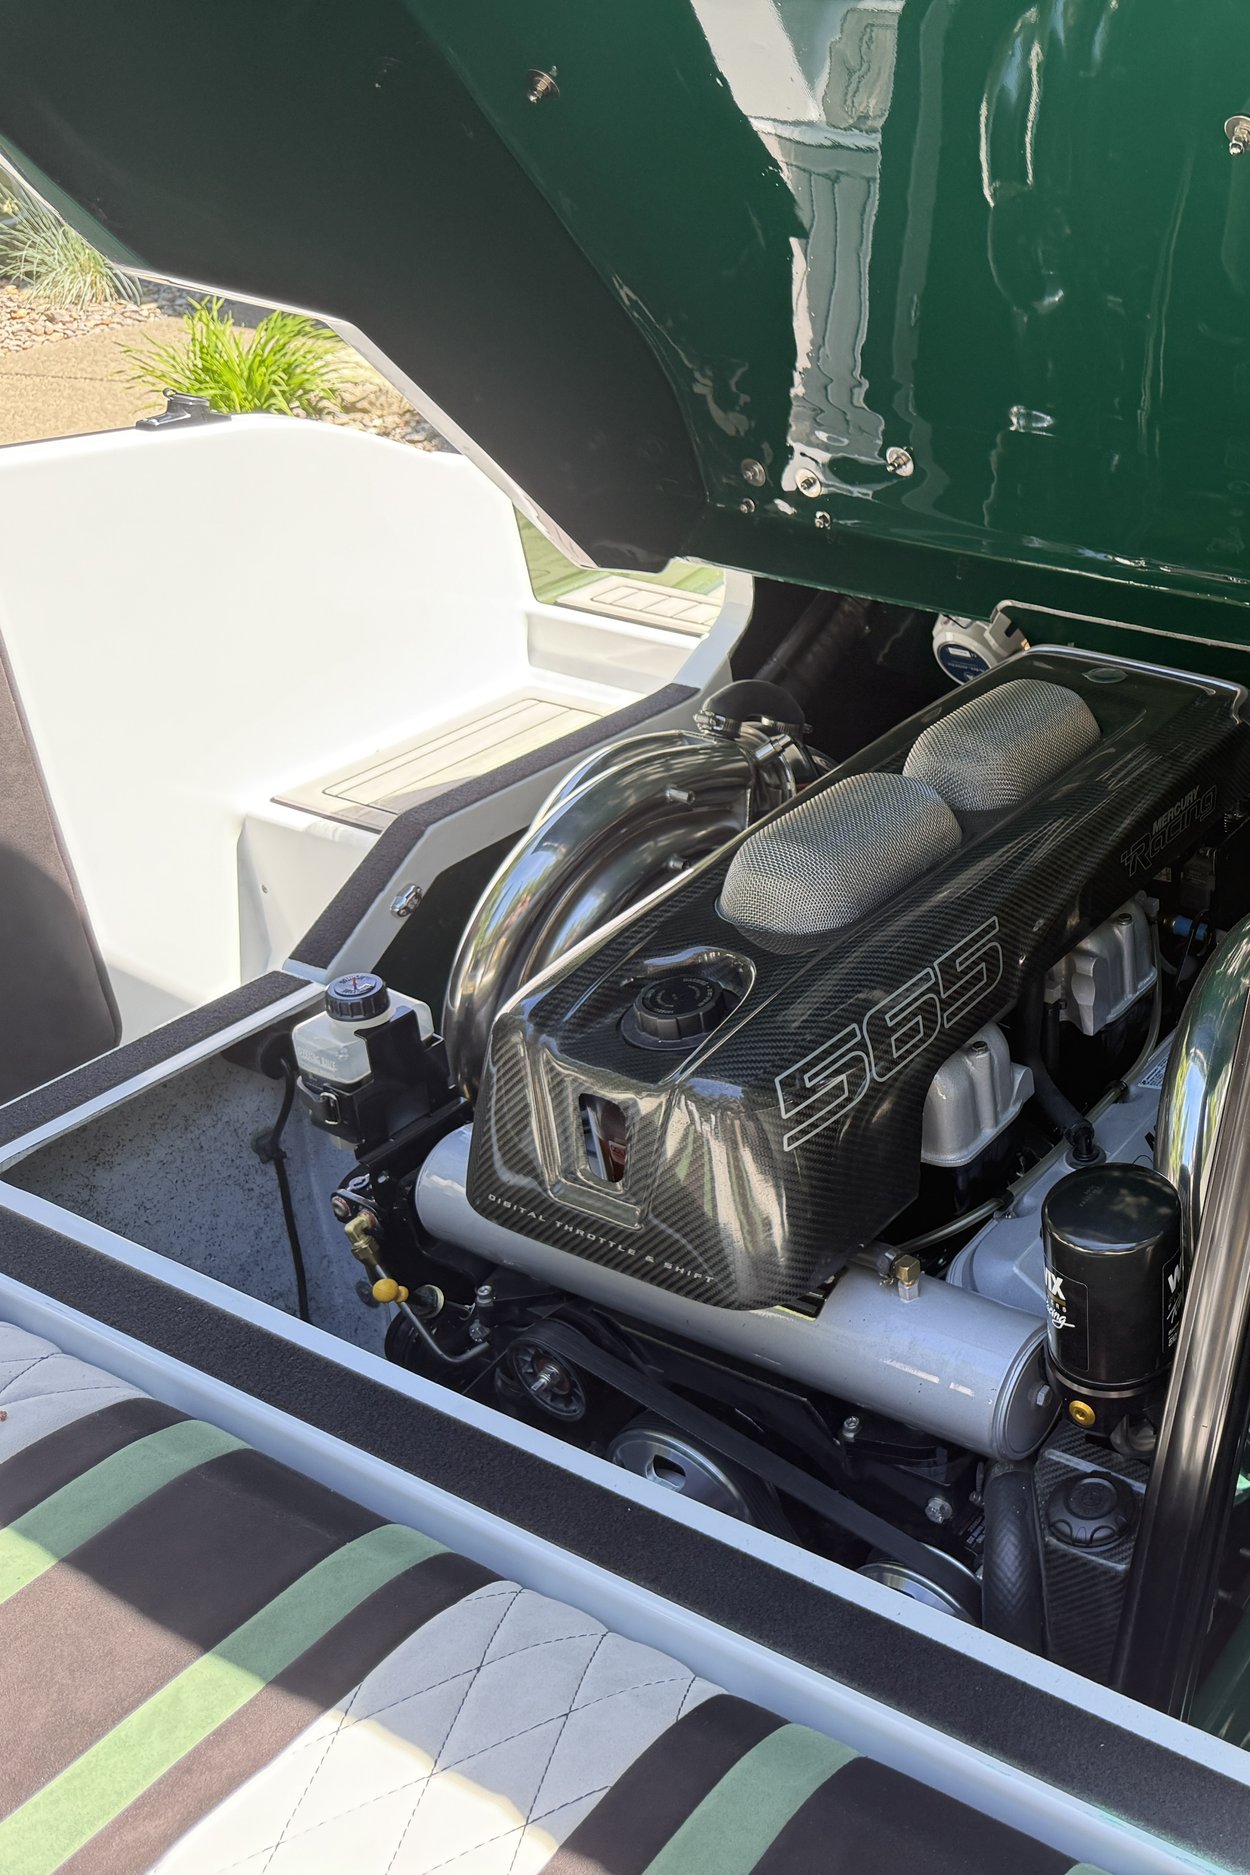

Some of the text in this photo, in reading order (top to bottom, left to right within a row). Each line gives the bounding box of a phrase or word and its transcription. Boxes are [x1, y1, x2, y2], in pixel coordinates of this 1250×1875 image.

[1121, 785, 1217, 877] Racing
[1153, 785, 1200, 835] MERCURY
[774, 916, 1003, 1152] 565
[488, 1193, 715, 1284] DIGITAL THROTTLE & SHIFT
